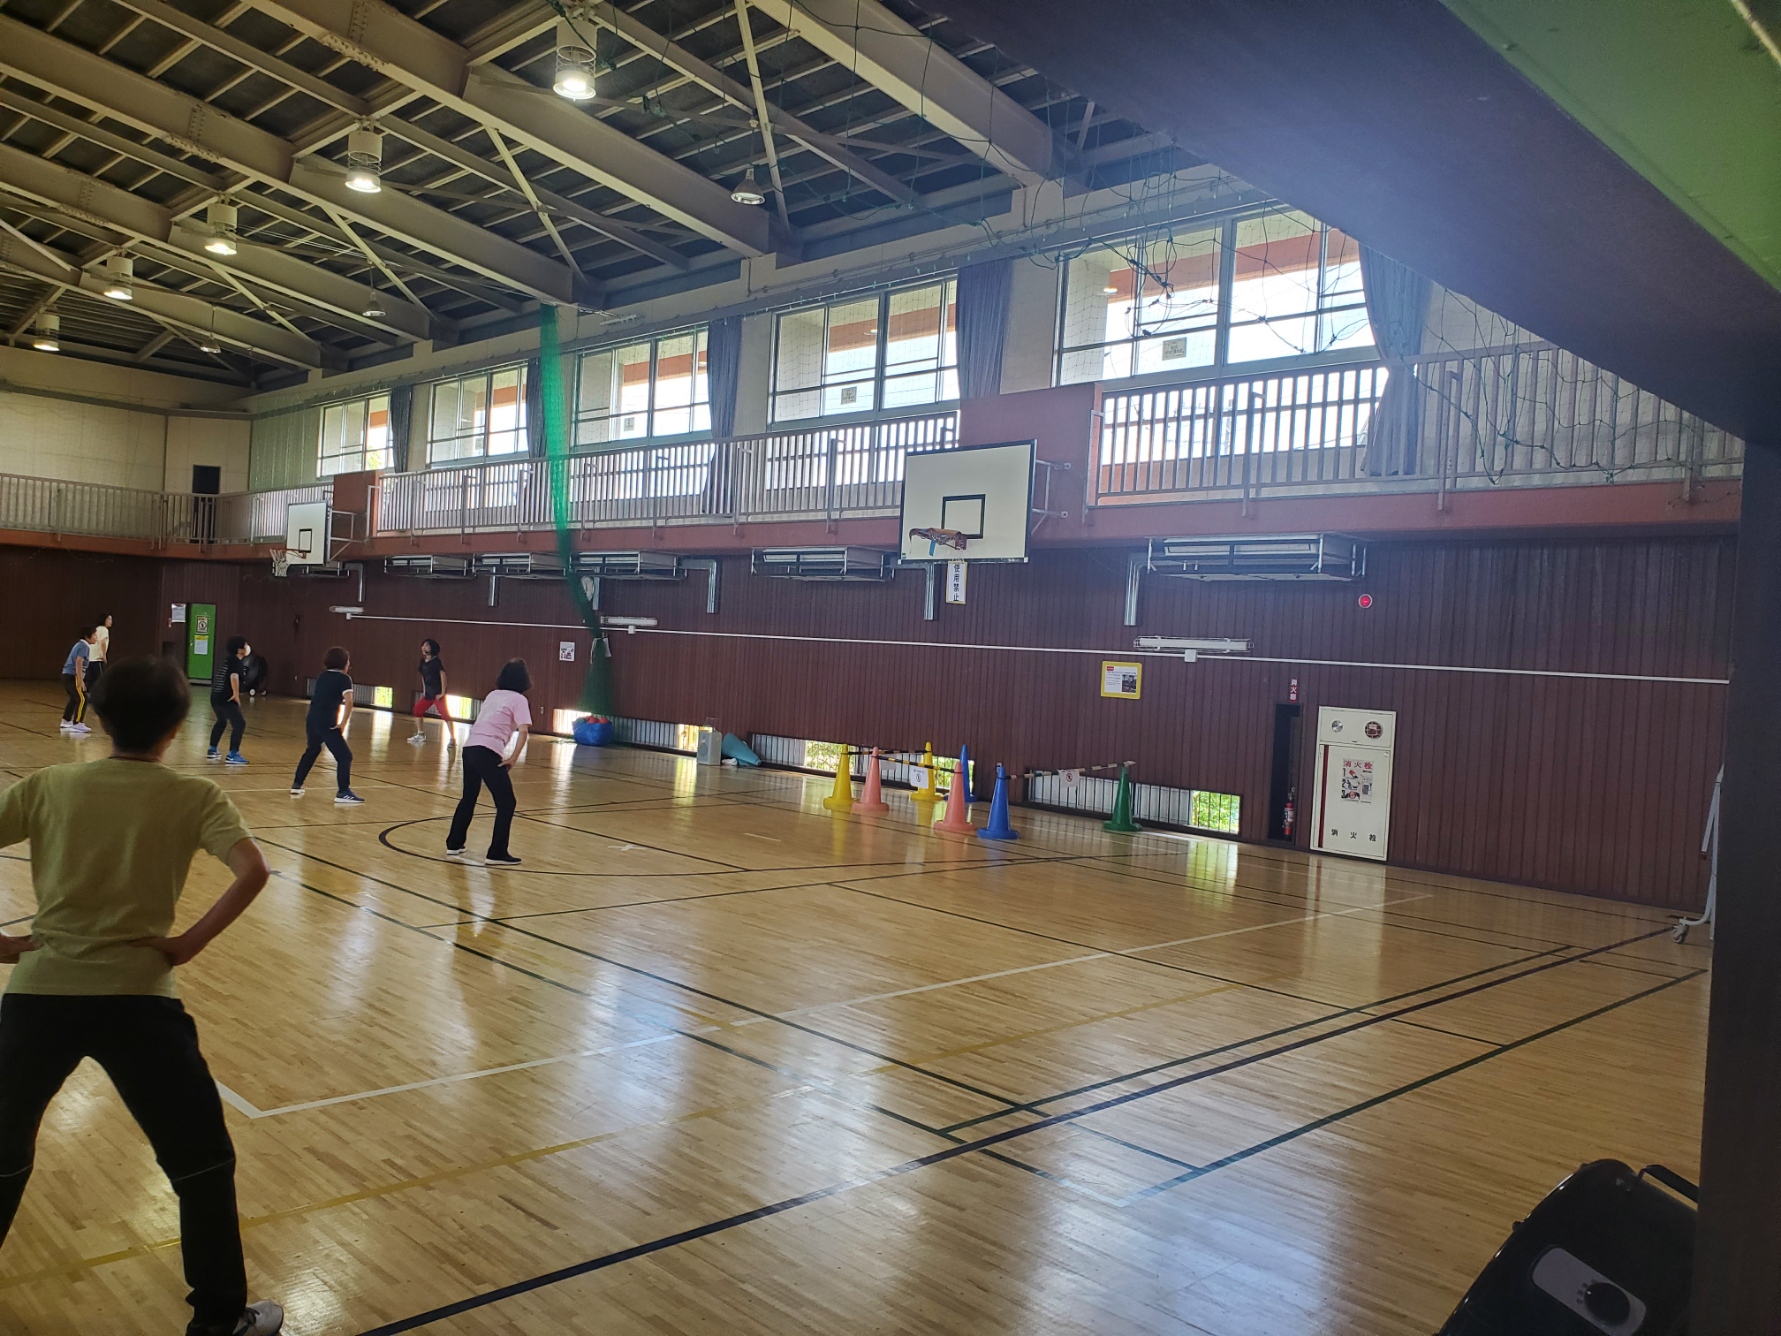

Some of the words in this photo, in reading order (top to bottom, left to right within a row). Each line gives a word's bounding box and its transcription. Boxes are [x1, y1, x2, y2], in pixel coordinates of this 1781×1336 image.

[1343, 760, 1373, 770] 消火栓
[1331, 828, 1376, 841] 消火栓
